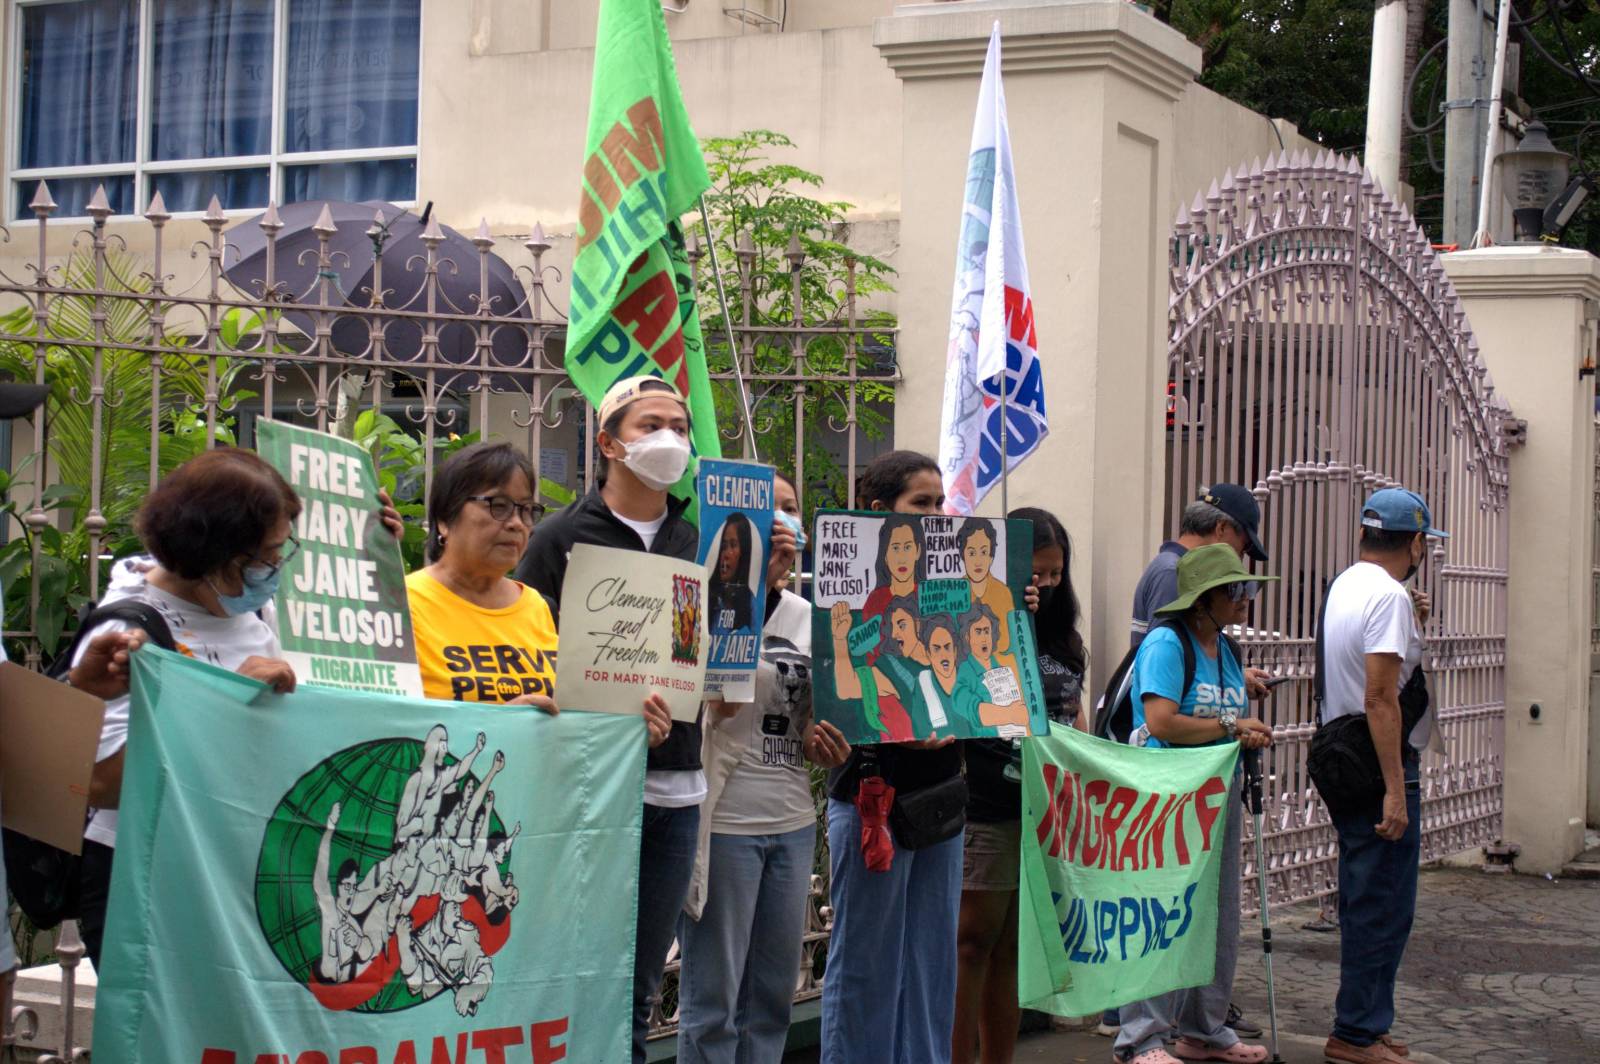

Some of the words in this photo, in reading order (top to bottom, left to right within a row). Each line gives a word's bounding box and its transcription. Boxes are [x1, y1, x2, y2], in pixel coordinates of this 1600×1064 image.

[290, 444, 365, 499] FREE
[705, 474, 771, 511] CLEMENCY
[822, 520, 858, 539] FREE
[821, 542, 858, 560] MARY
[927, 553, 962, 575] FLOR
[293, 551, 380, 603] JANE
[819, 560, 854, 578] JANE
[586, 577, 666, 624] Clemency
[286, 600, 405, 649] VELOSO!
[611, 612, 650, 642] and
[717, 609, 736, 629] FOR
[587, 631, 661, 669] Freedom
[720, 634, 758, 663] JANE!
[850, 619, 880, 651] SAHOD
[310, 656, 398, 687] MIGRANTE
[1014, 610, 1038, 716] KARAPATAN
[497, 682, 521, 694] the
[584, 669, 609, 682] FOR
[613, 671, 647, 684] MARY
[649, 674, 671, 688] JANE
[671, 679, 696, 692] VELOSO
